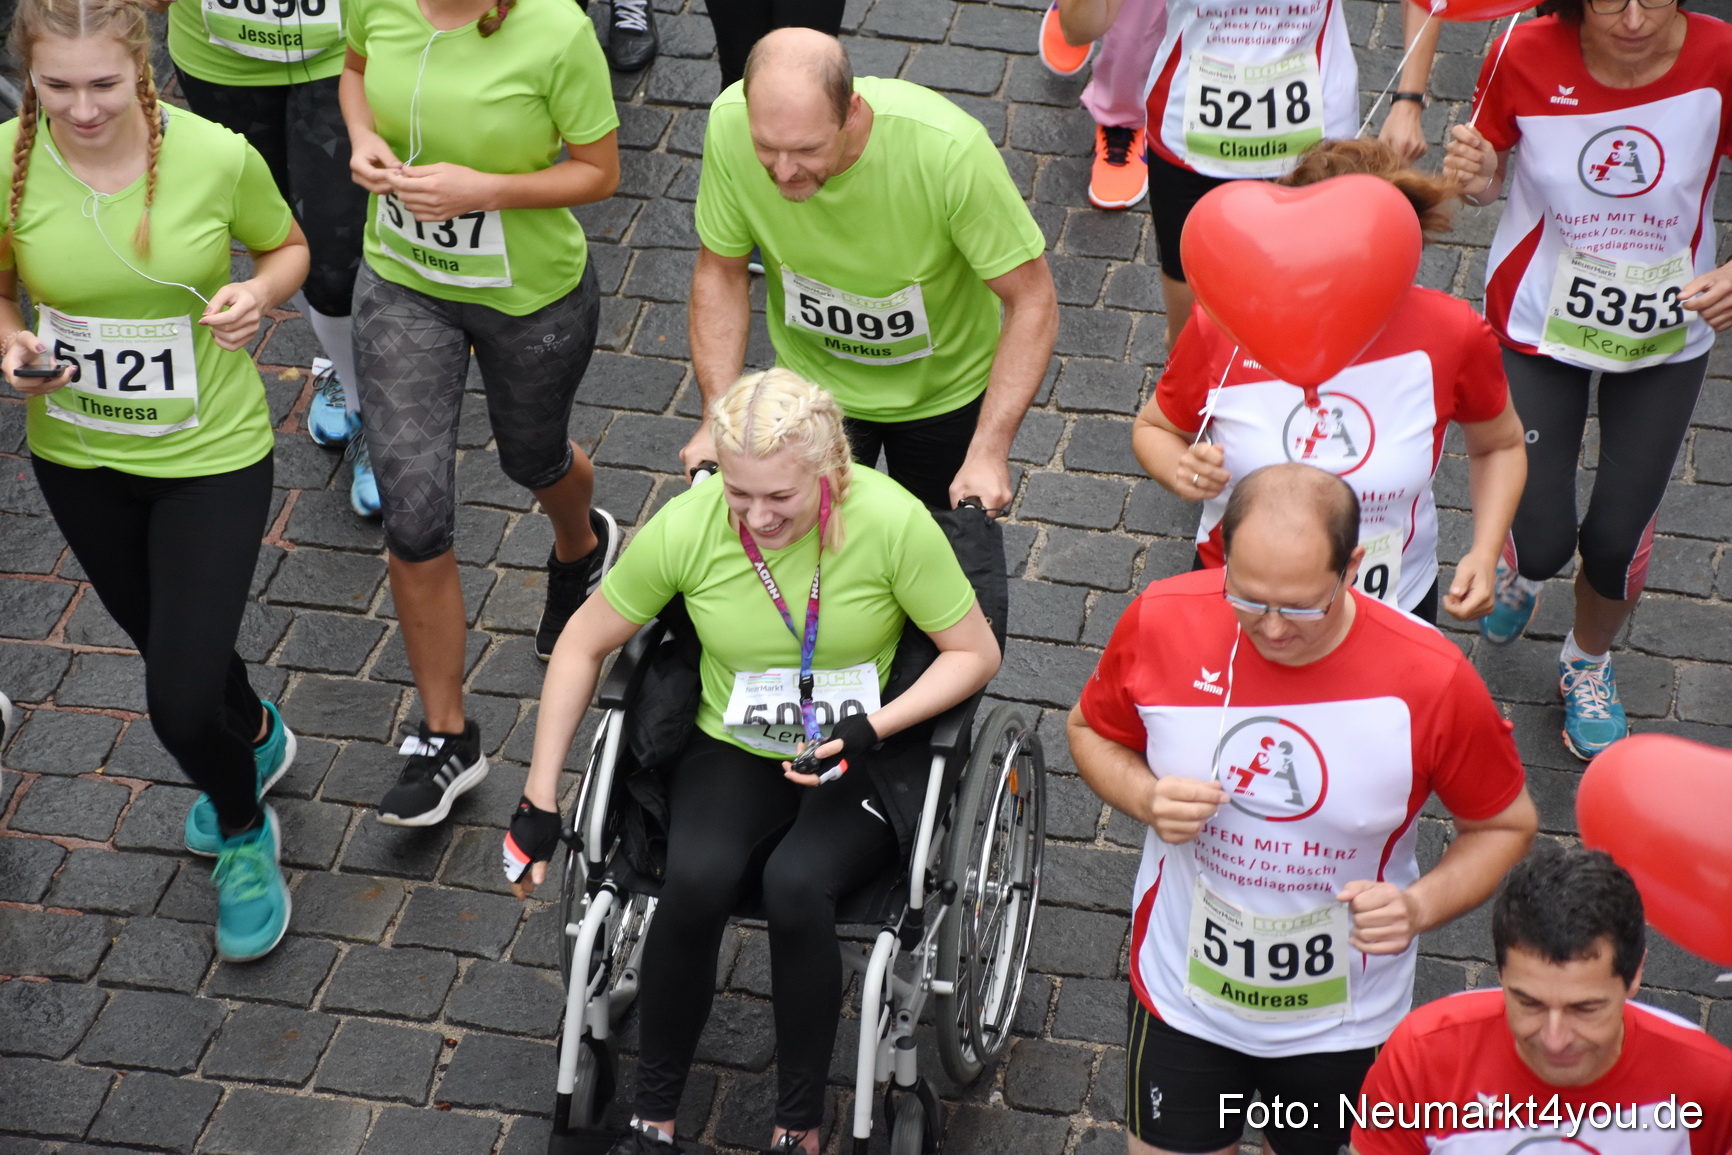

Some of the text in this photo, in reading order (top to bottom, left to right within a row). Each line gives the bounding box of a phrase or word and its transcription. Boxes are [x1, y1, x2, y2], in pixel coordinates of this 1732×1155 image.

[1255, 6, 1281, 16] MIT
[1288, 1, 1321, 16] HERZ
[238, 24, 303, 46] Jessica
[1206, 35, 1306, 46] Leistungsdiagnost
[1199, 80, 1311, 130] 5218
[1550, 95, 1579, 106] erima
[1219, 141, 1287, 157] Claudia
[1607, 213, 1636, 222] MIT
[1643, 213, 1680, 228] HERZ
[412, 248, 459, 272] Elena
[1625, 256, 1684, 283] BOCK
[800, 293, 914, 340] 5099
[1567, 276, 1684, 333] 5353
[100, 323, 177, 338] BOCK
[1578, 325, 1657, 357] Renate
[824, 337, 892, 356] Markus
[54, 339, 175, 391] 5121
[78, 396, 157, 420] Theresa
[754, 562, 780, 600] HUDY
[793, 670, 863, 689] OCK
[1193, 680, 1223, 695] erima
[762, 724, 806, 744] Len
[1212, 846, 1245, 867] Heck
[1260, 861, 1282, 874] Dr.
[1255, 838, 1292, 855] MIT
[1303, 841, 1358, 861] HERZ
[1194, 849, 1333, 893] Leistungsdiagnostik
[1203, 917, 1334, 981] 5198
[1220, 982, 1309, 1008] Andreas
